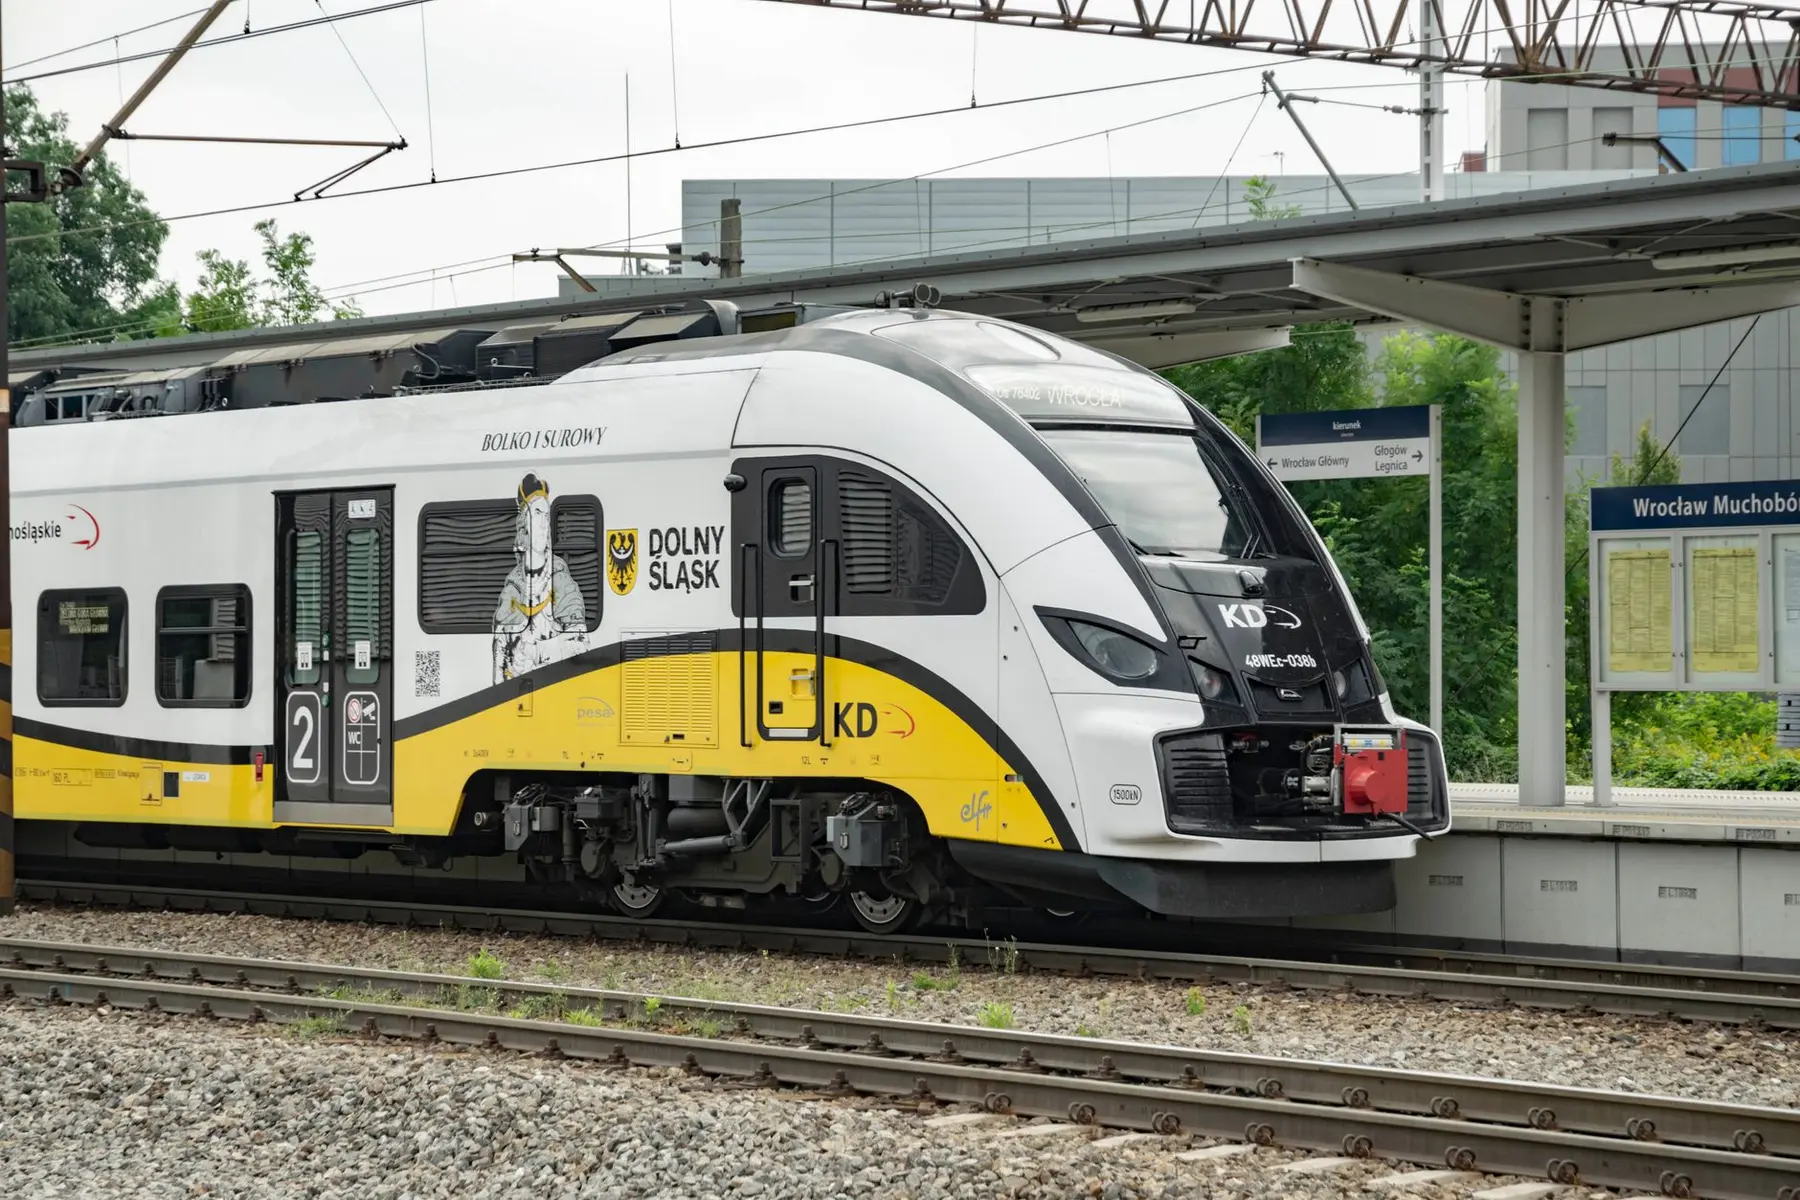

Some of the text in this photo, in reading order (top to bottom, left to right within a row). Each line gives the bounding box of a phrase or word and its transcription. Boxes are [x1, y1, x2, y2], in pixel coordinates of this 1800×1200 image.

[1332, 421, 1361, 430] kierunek
[482, 426, 608, 451] BOLKO I SUROWY
[1281, 456, 1350, 468] Wrocław Główny
[1374, 445, 1408, 459] Głogów
[1375, 460, 1408, 473] Legnica
[1633, 496, 1708, 518] Wrocław
[9, 521, 62, 544] nośląskie
[648, 526, 725, 557] DOLNY
[648, 555, 721, 594] ŚLĄSK
[1218, 604, 1268, 628] KD
[1245, 654, 1317, 669] 48WEc-038b
[833, 702, 878, 739] KD
[292, 705, 314, 769] 2
[347, 732, 361, 745] WC
[1112, 788, 1139, 802] 1500kN
